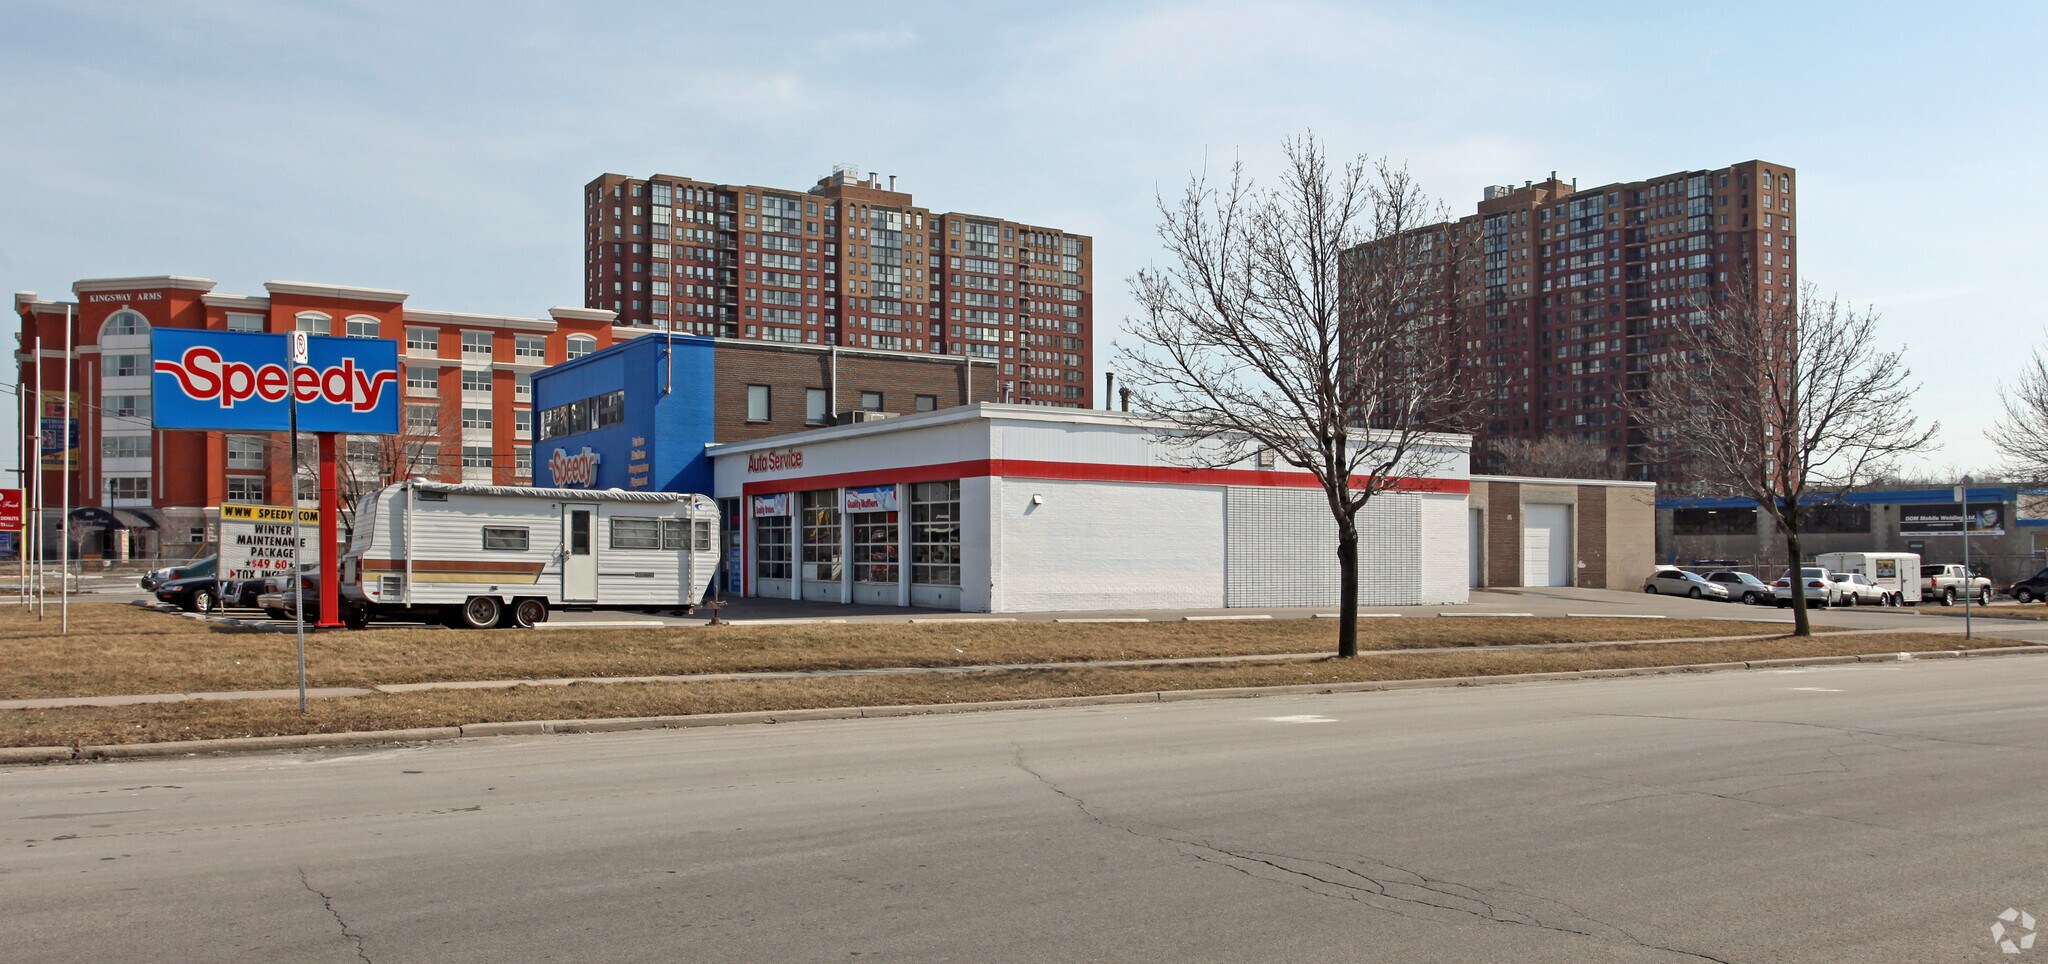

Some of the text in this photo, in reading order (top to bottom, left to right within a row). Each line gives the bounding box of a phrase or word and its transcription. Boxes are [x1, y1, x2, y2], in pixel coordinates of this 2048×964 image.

[89, 292, 162, 302] KINGSWAY ARMS
[155, 346, 397, 412] Speedy
[549, 447, 598, 488] Speedy
[748, 450, 803, 473] Auto Service
[225, 506, 318, 521] WWW SPEEDY COM
[255, 525, 292, 535] WINTER
[237, 535, 306, 547] MAINTENANE
[251, 547, 294, 558] PACKAGE
[252, 559, 287, 569] $49 60
